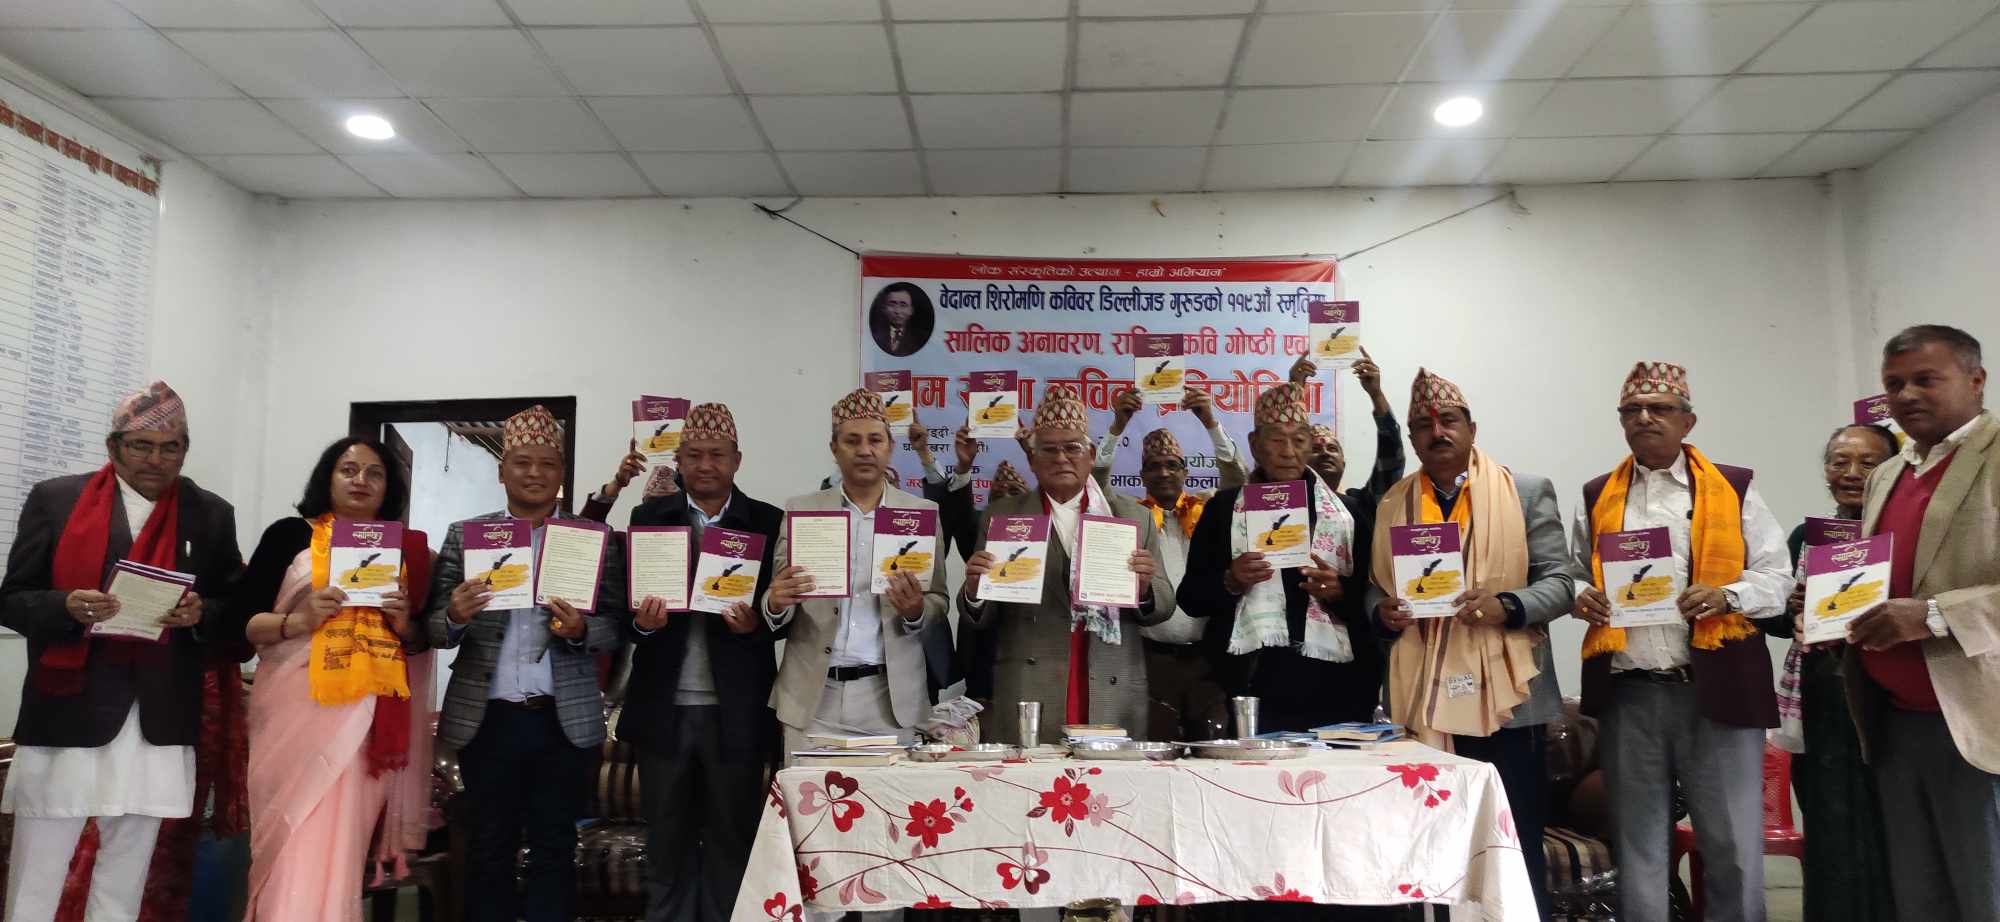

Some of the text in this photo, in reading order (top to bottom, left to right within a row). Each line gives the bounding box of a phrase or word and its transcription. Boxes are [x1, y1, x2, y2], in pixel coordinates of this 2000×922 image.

[939, 283, 982, 310] वेदान्त
[985, 283, 1046, 311] शिरोमणि
[1049, 284, 1096, 312] कविवर
[943, 322, 1012, 354] सालिक
[1183, 326, 1219, 357] कवि
[1223, 326, 1277, 357] गोष्ठी
